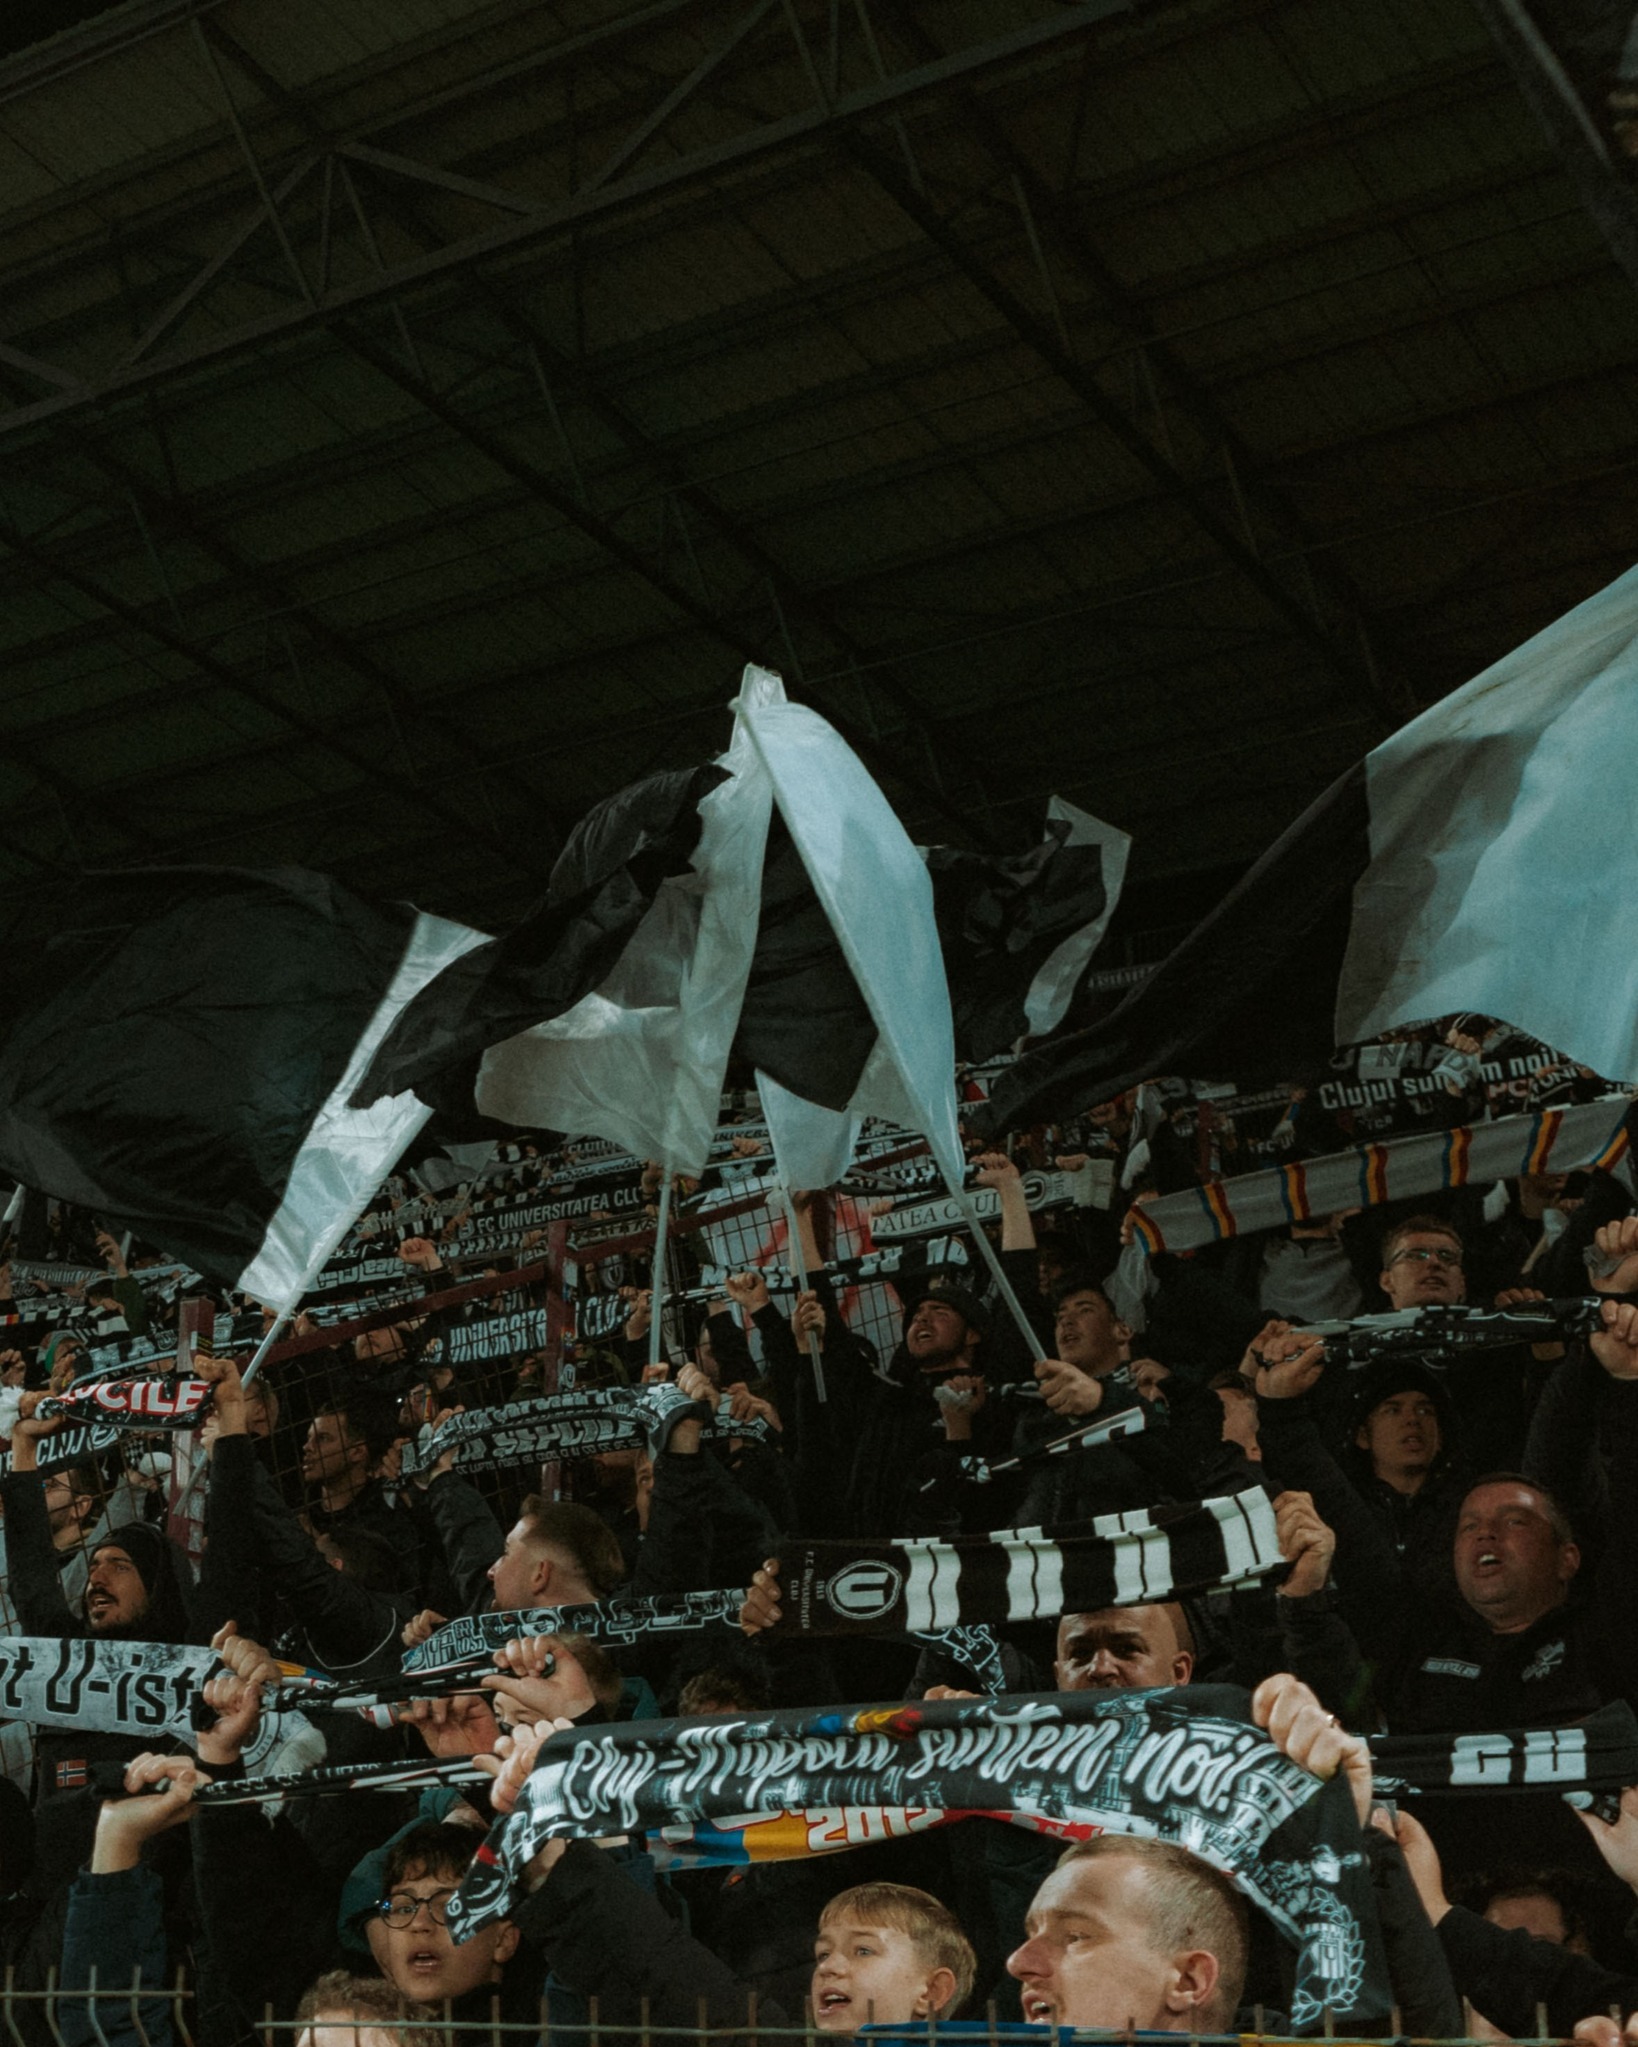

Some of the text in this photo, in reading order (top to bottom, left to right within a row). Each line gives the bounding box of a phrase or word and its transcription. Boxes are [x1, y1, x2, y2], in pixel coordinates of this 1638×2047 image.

[1319, 1073, 1397, 1110] Clujul
[1402, 1058, 1503, 1097] sunm
[477, 1216, 495, 1231] FC
[499, 1194, 610, 1231] UNIVERSITATEA
[943, 1193, 999, 1220] CUJ
[36, 1426, 86, 1467] CLUJ
[905, 1702, 1122, 1793] suntem
